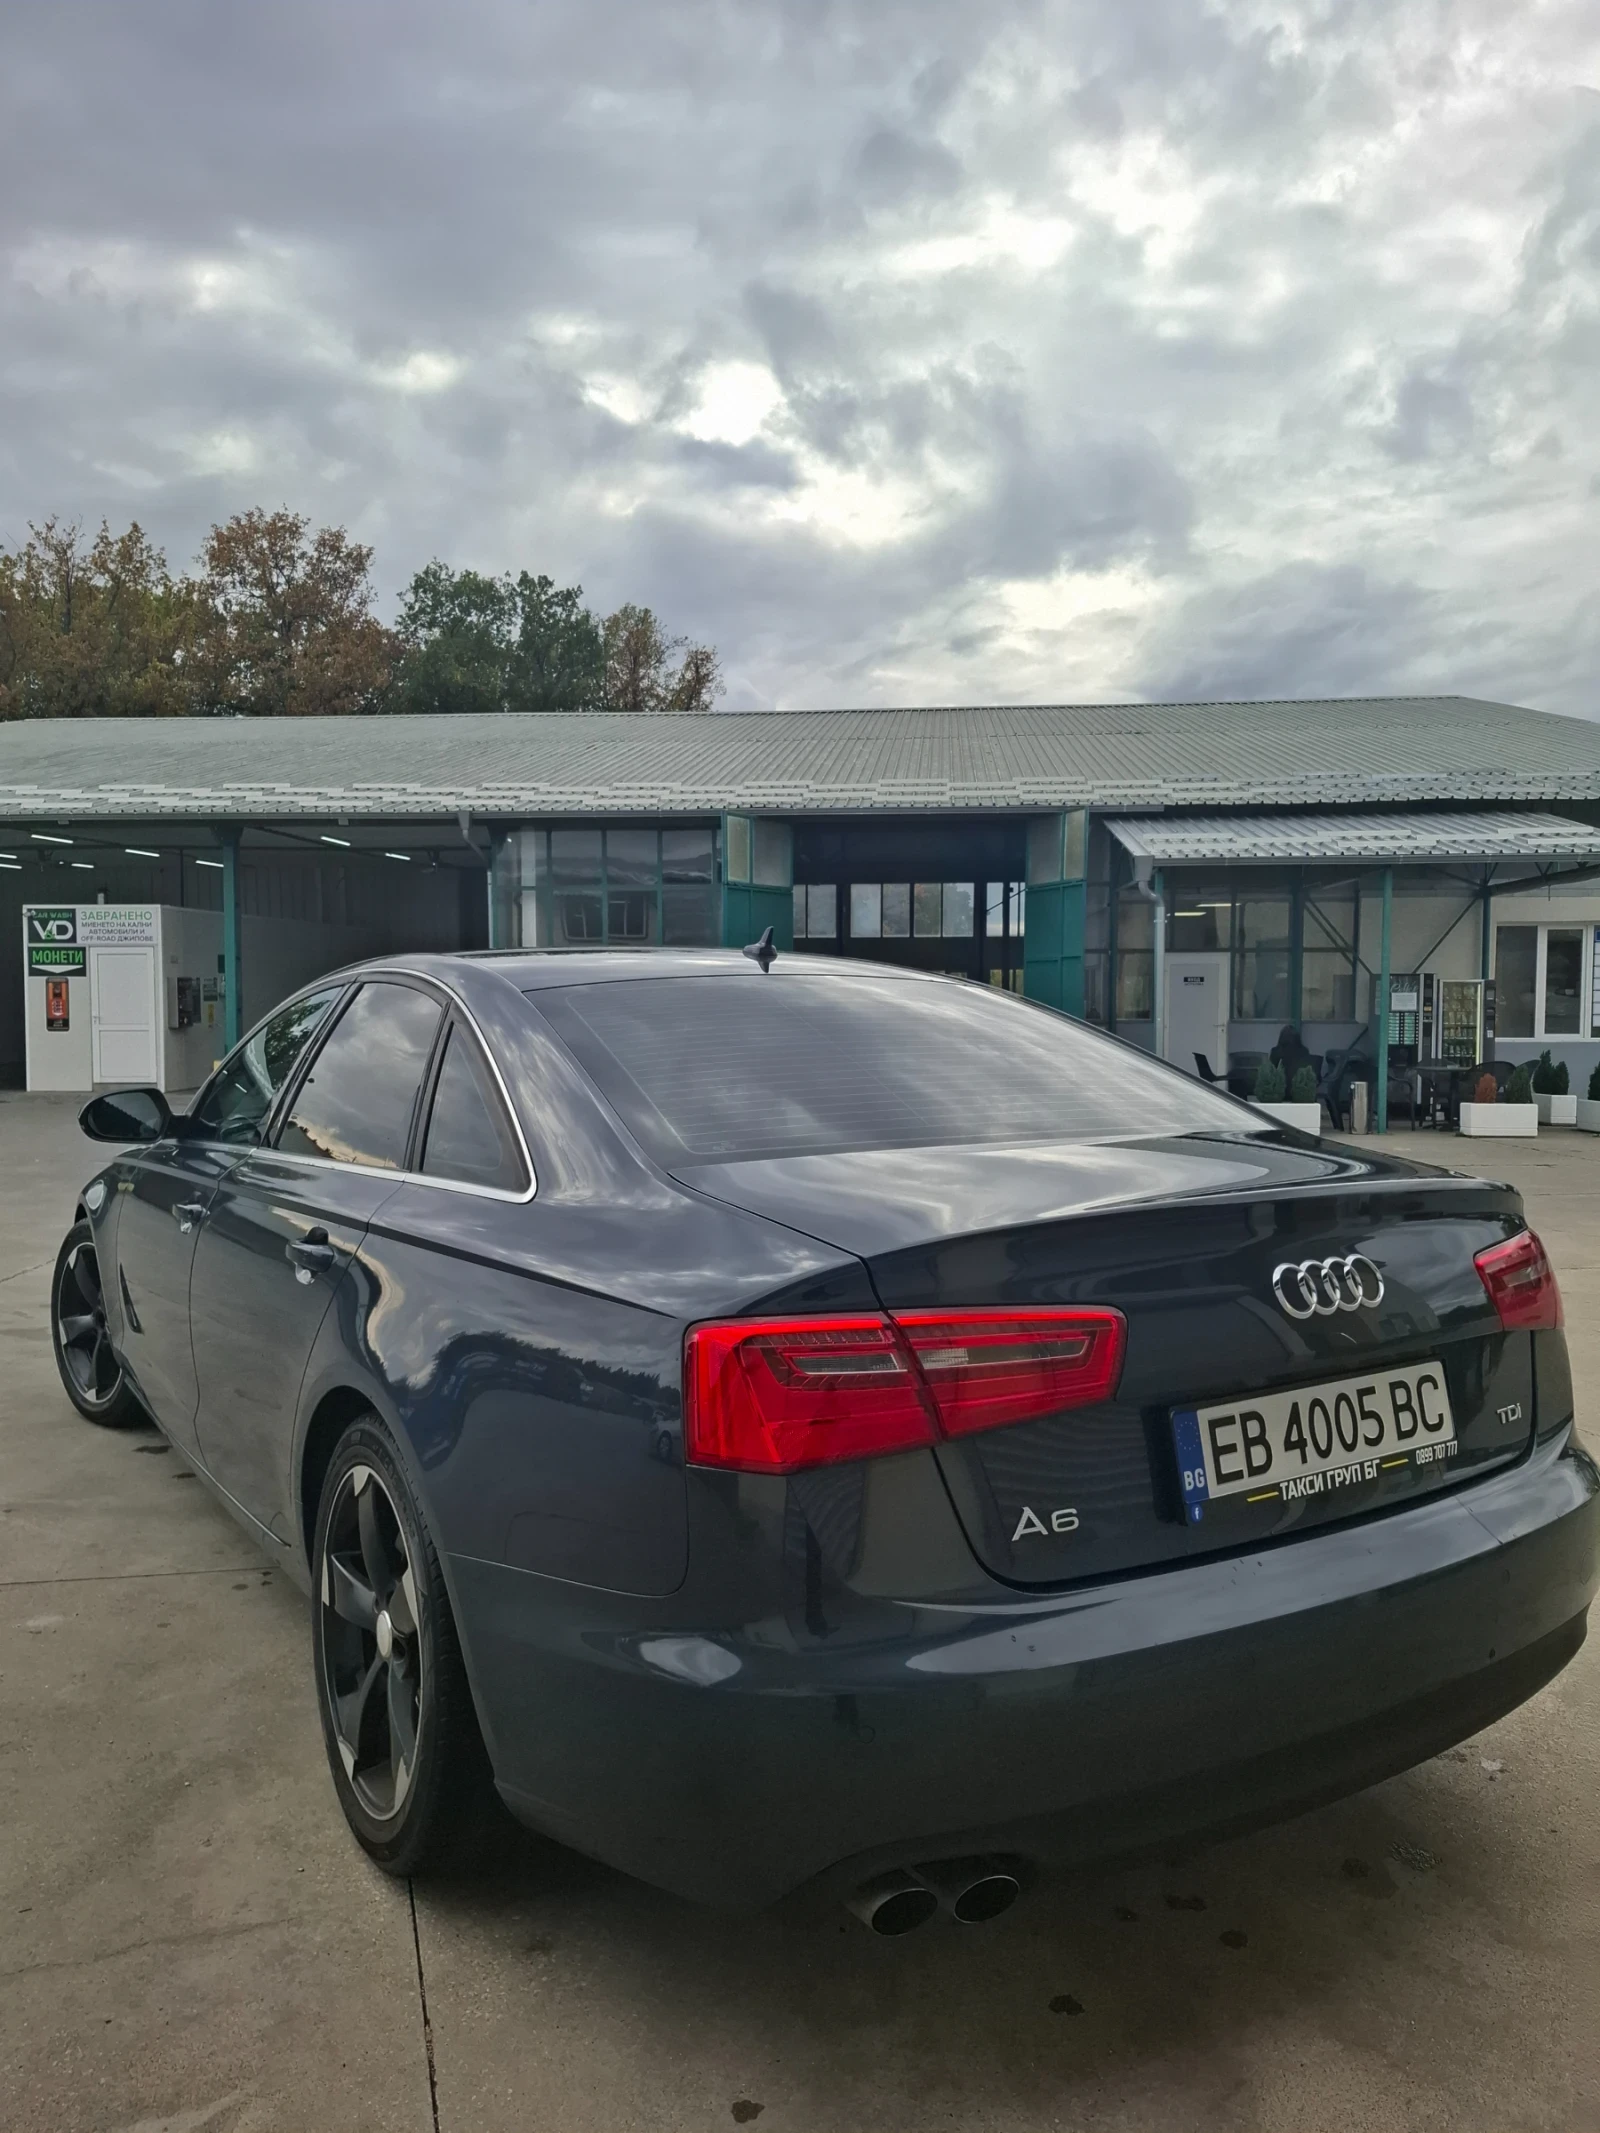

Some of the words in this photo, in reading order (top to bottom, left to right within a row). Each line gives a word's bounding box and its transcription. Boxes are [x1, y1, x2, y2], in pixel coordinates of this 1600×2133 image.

[80, 911, 153, 921] ЗАБРАНЕНО
[32, 950, 83, 964] МОНЕТИ
[1207, 1410, 1273, 1486] EB
[1284, 1386, 1385, 1465] 4005
[1388, 1374, 1444, 1441] BC
[1415, 1447, 1434, 1465] 0899
[1446, 1440, 1458, 1457] 777
[1183, 1468, 1205, 1491] BG
[1279, 1473, 1324, 1501] ТАКСИ
[1327, 1464, 1362, 1490] ГРУП
[1364, 1459, 1381, 1480] БГ
[1011, 1506, 1080, 1542] A6
